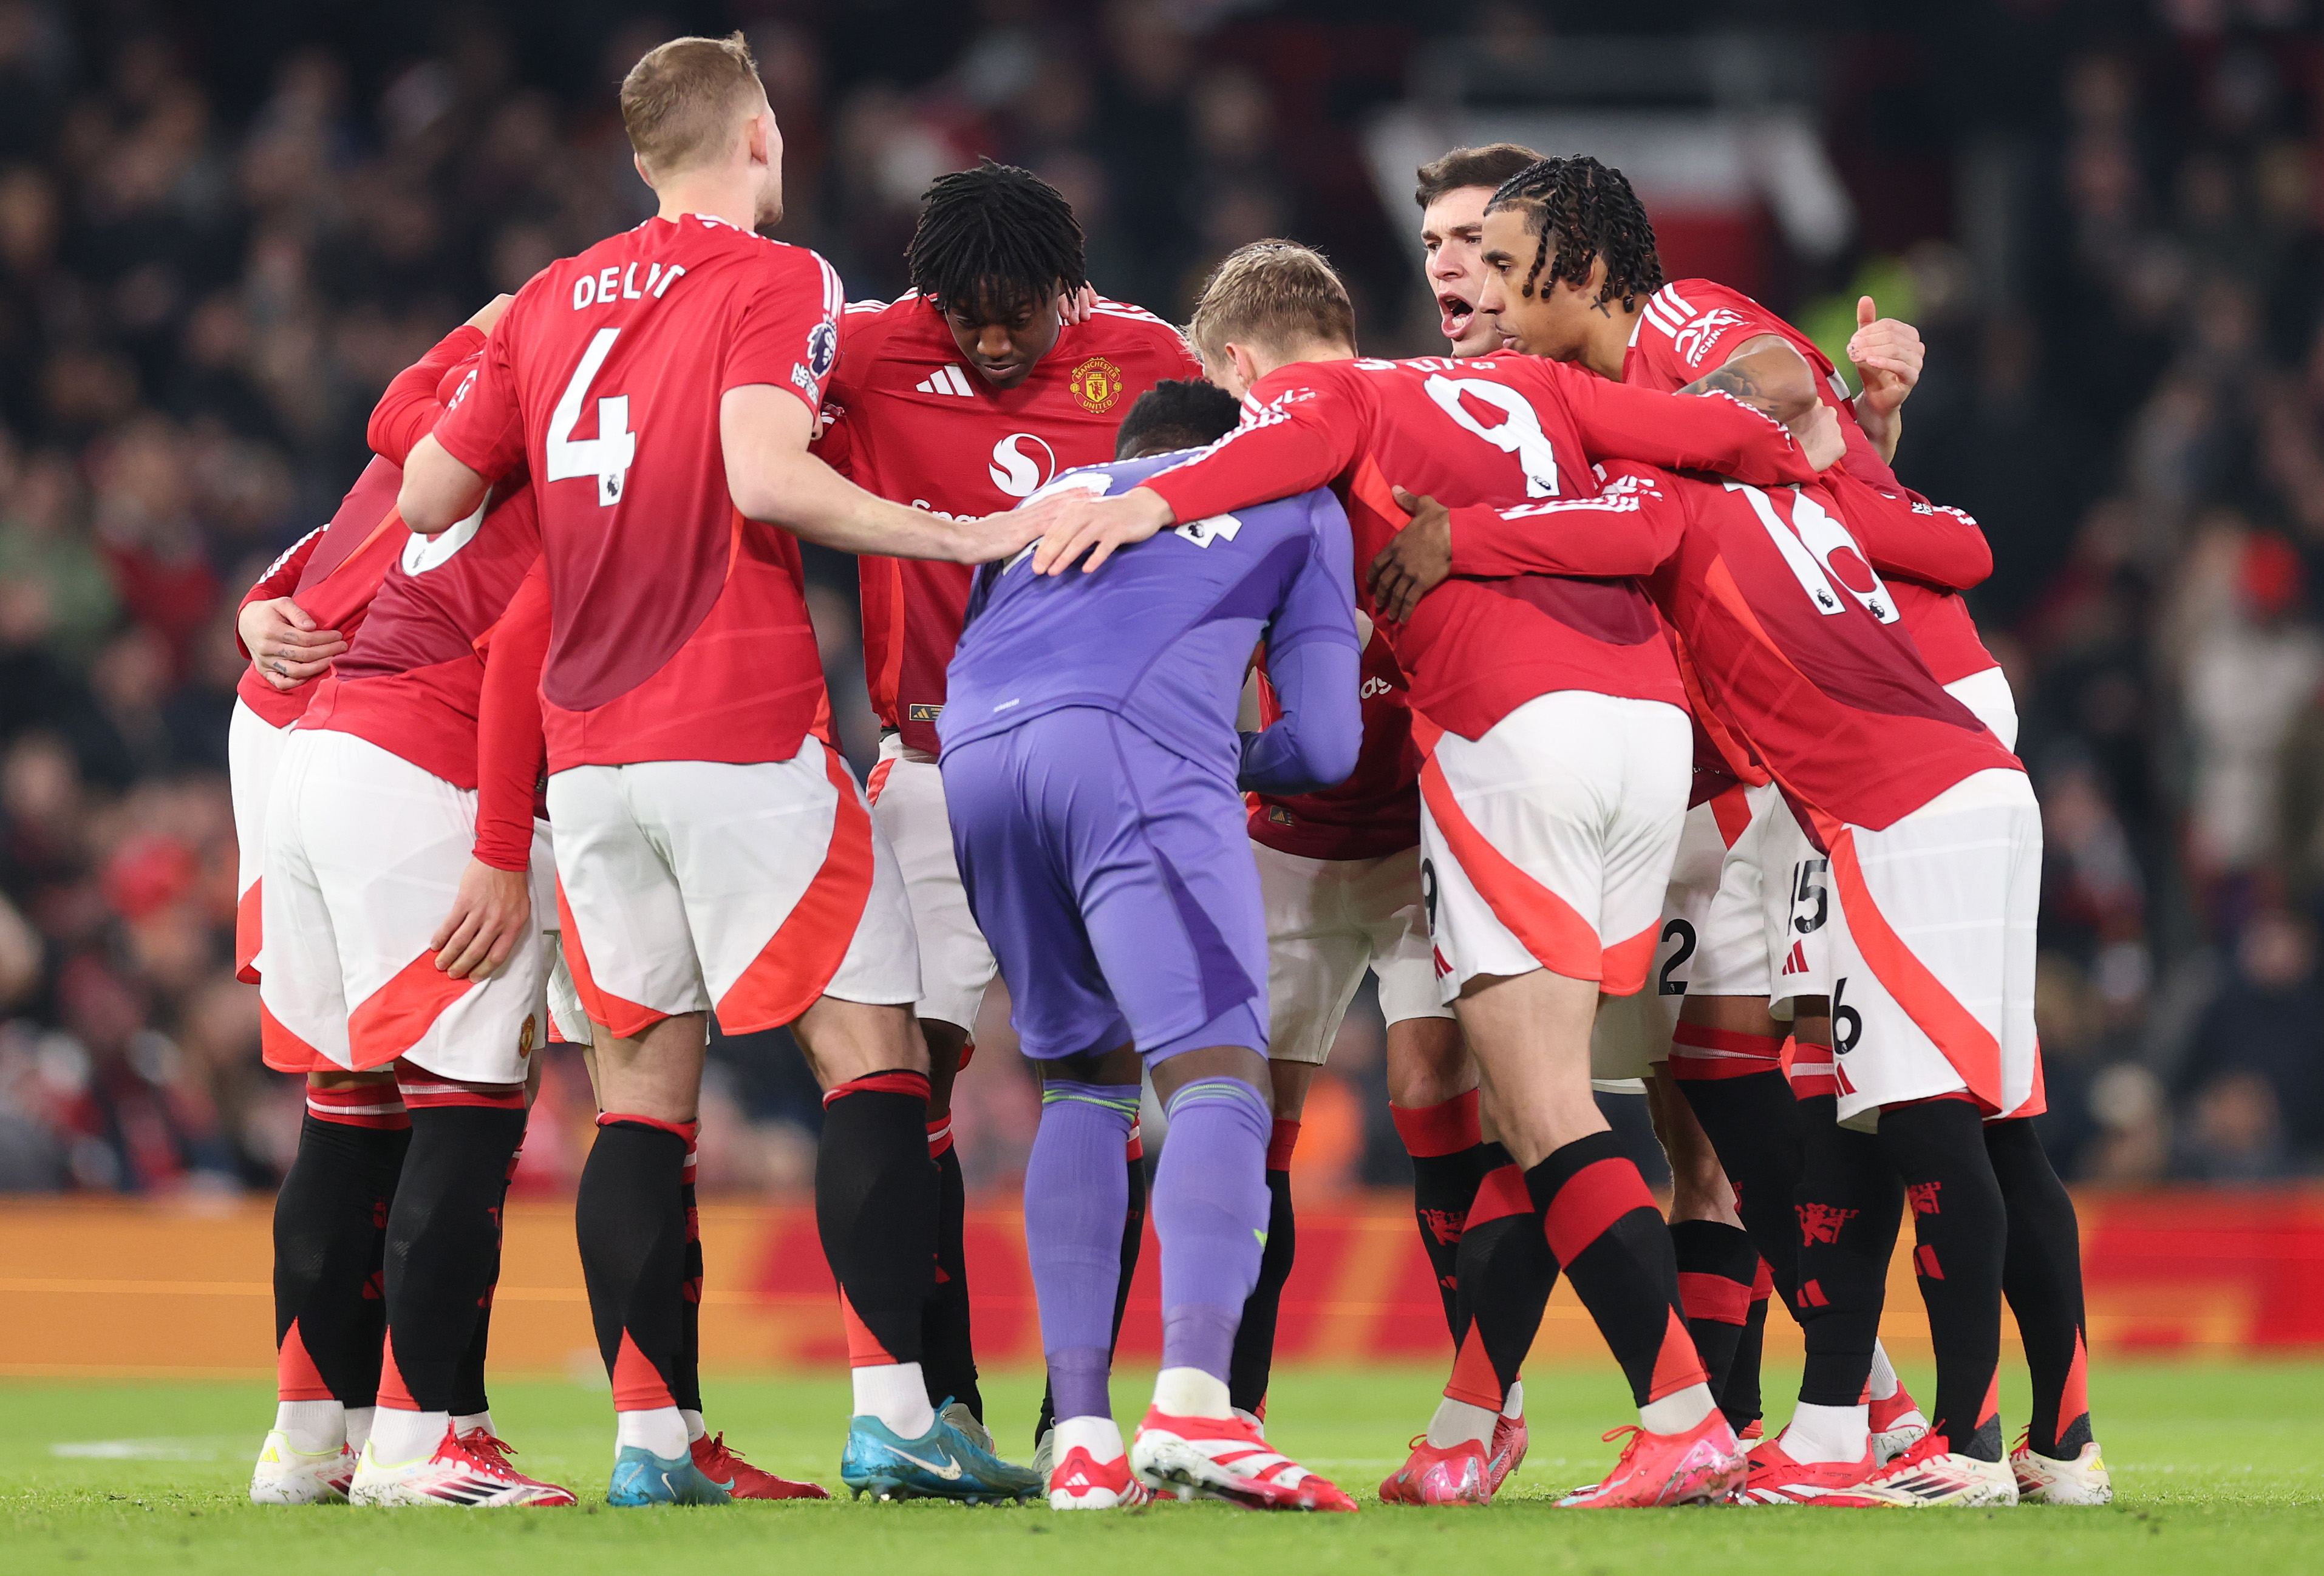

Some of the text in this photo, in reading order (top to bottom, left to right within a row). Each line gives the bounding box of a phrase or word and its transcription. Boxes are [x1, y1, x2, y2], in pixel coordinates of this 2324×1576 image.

[1075, 361, 1117, 379] MANCHESTER
[1691, 328, 1728, 368] TECHN
[546, 327, 636, 508] 4
[1083, 399, 1113, 410] UNITED
[1423, 373, 1561, 499] 9
[1721, 480, 1901, 625] 16
[1658, 919, 1697, 995] 2
[1833, 977, 1862, 1055] 6
